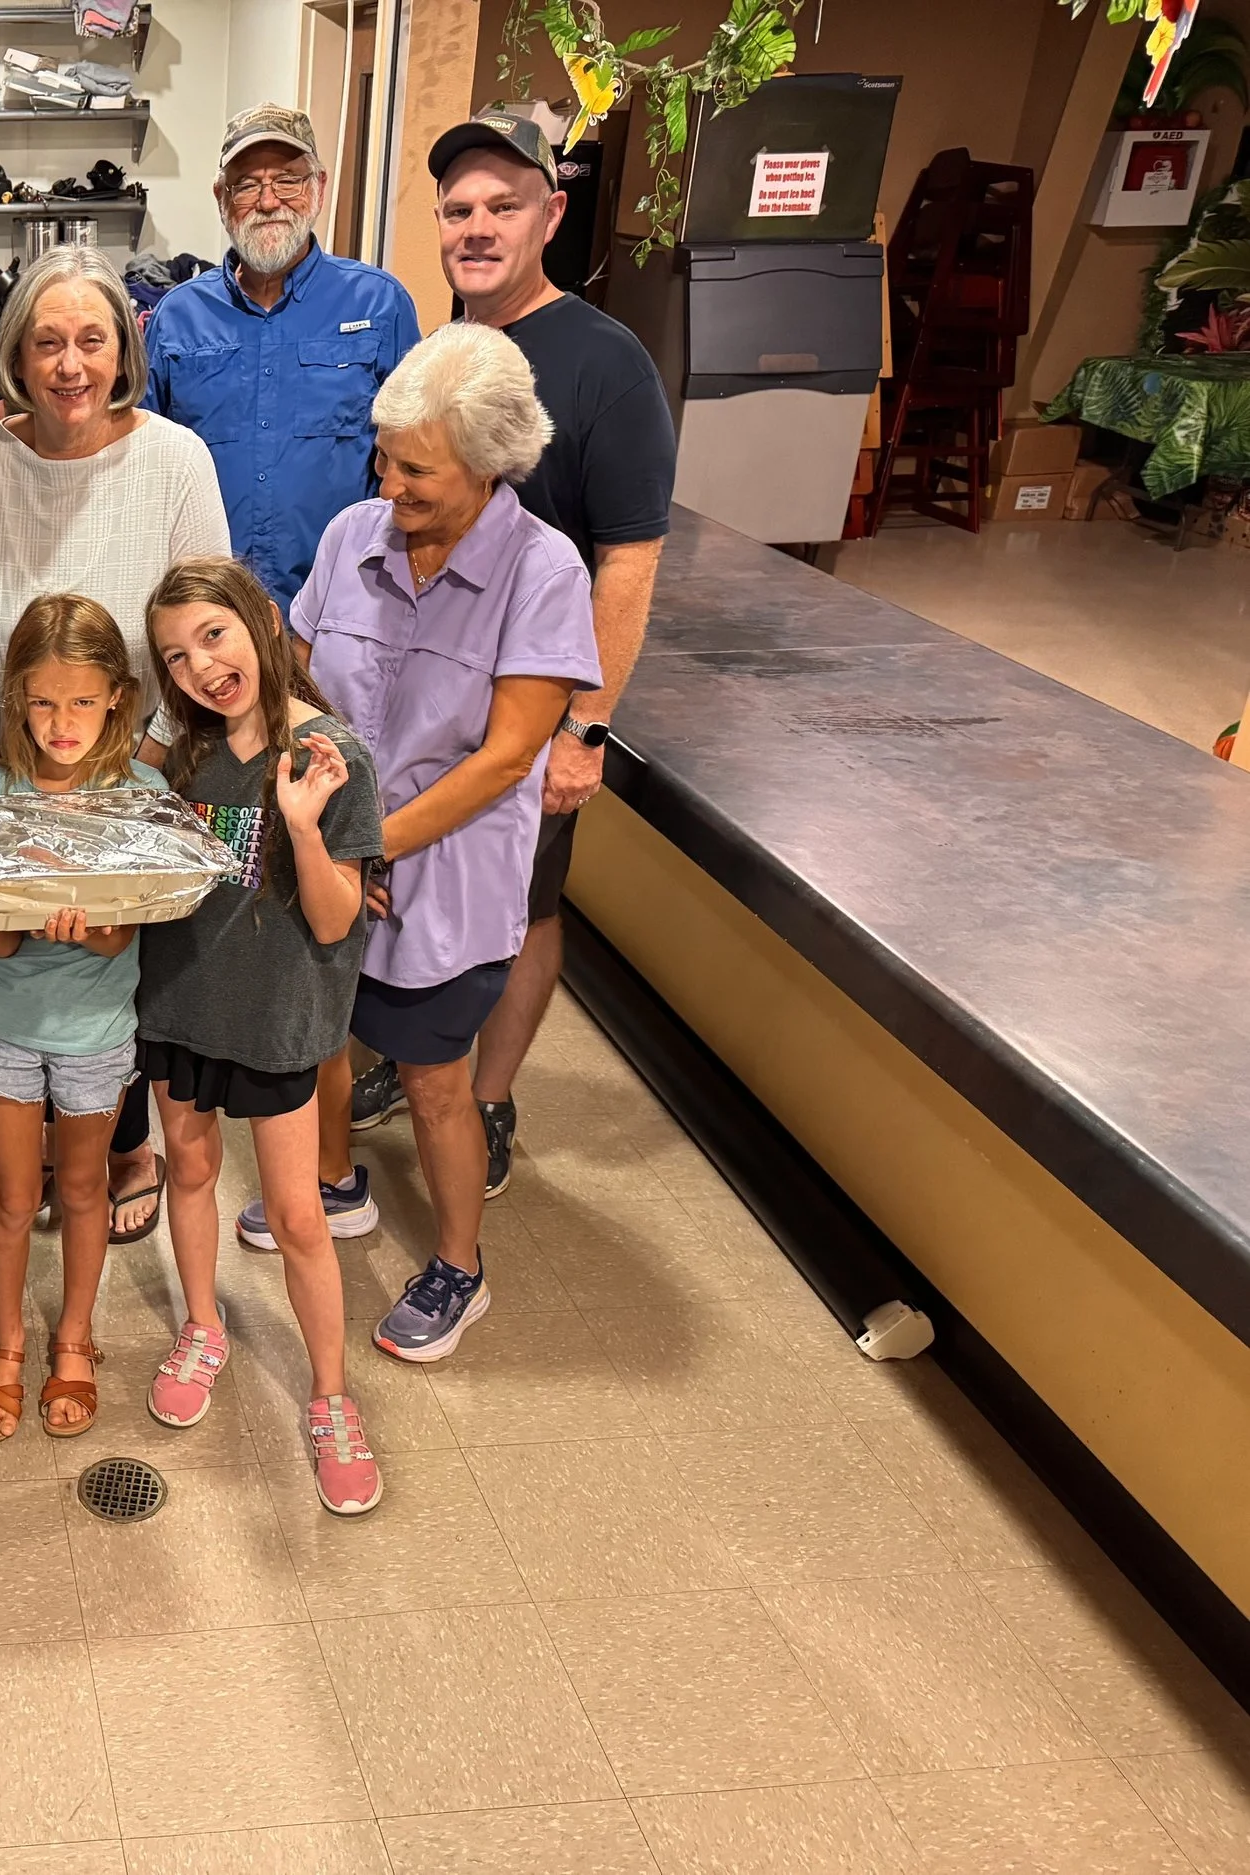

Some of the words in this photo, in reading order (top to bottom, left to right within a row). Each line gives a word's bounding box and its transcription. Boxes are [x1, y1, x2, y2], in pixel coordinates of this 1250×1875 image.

[862, 81, 895, 89] Scotsman
[1161, 131, 1184, 140] AED
[763, 159, 784, 169] Please
[785, 160, 800, 169] wear
[800, 159, 821, 170] gloves
[765, 172, 782, 182] when
[782, 172, 804, 183] getting
[758, 190, 767, 199] Do
[768, 190, 778, 199] not
[778, 189, 789, 200] put
[790, 189, 800, 198] ice
[800, 188, 815, 198] back
[771, 203, 781, 212] the
